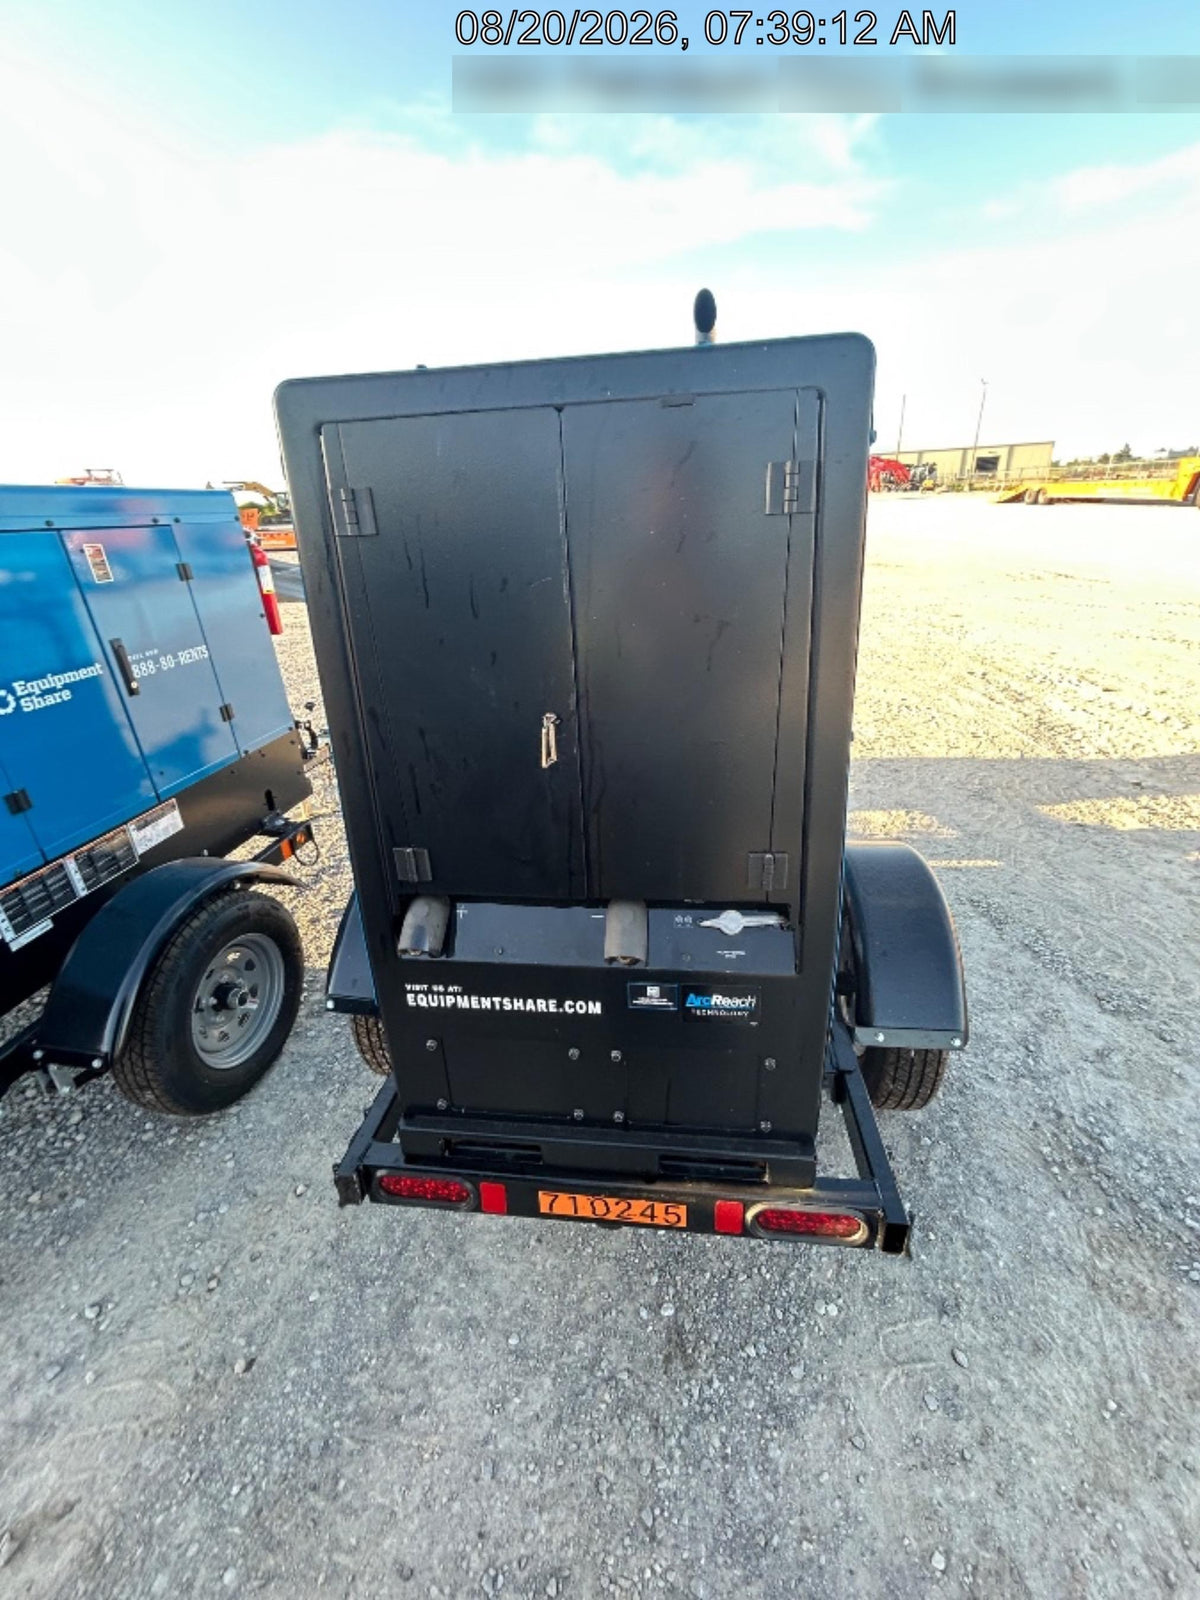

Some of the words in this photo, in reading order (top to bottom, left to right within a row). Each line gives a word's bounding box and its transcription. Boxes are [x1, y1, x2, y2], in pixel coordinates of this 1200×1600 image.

[12, 662, 103, 696] Equipment
[20, 689, 72, 712] Share
[406, 993, 602, 1014] EQUIPMENTSHARE.COM
[685, 993, 757, 1008] ArcReach
[542, 1191, 682, 1226] 710245
